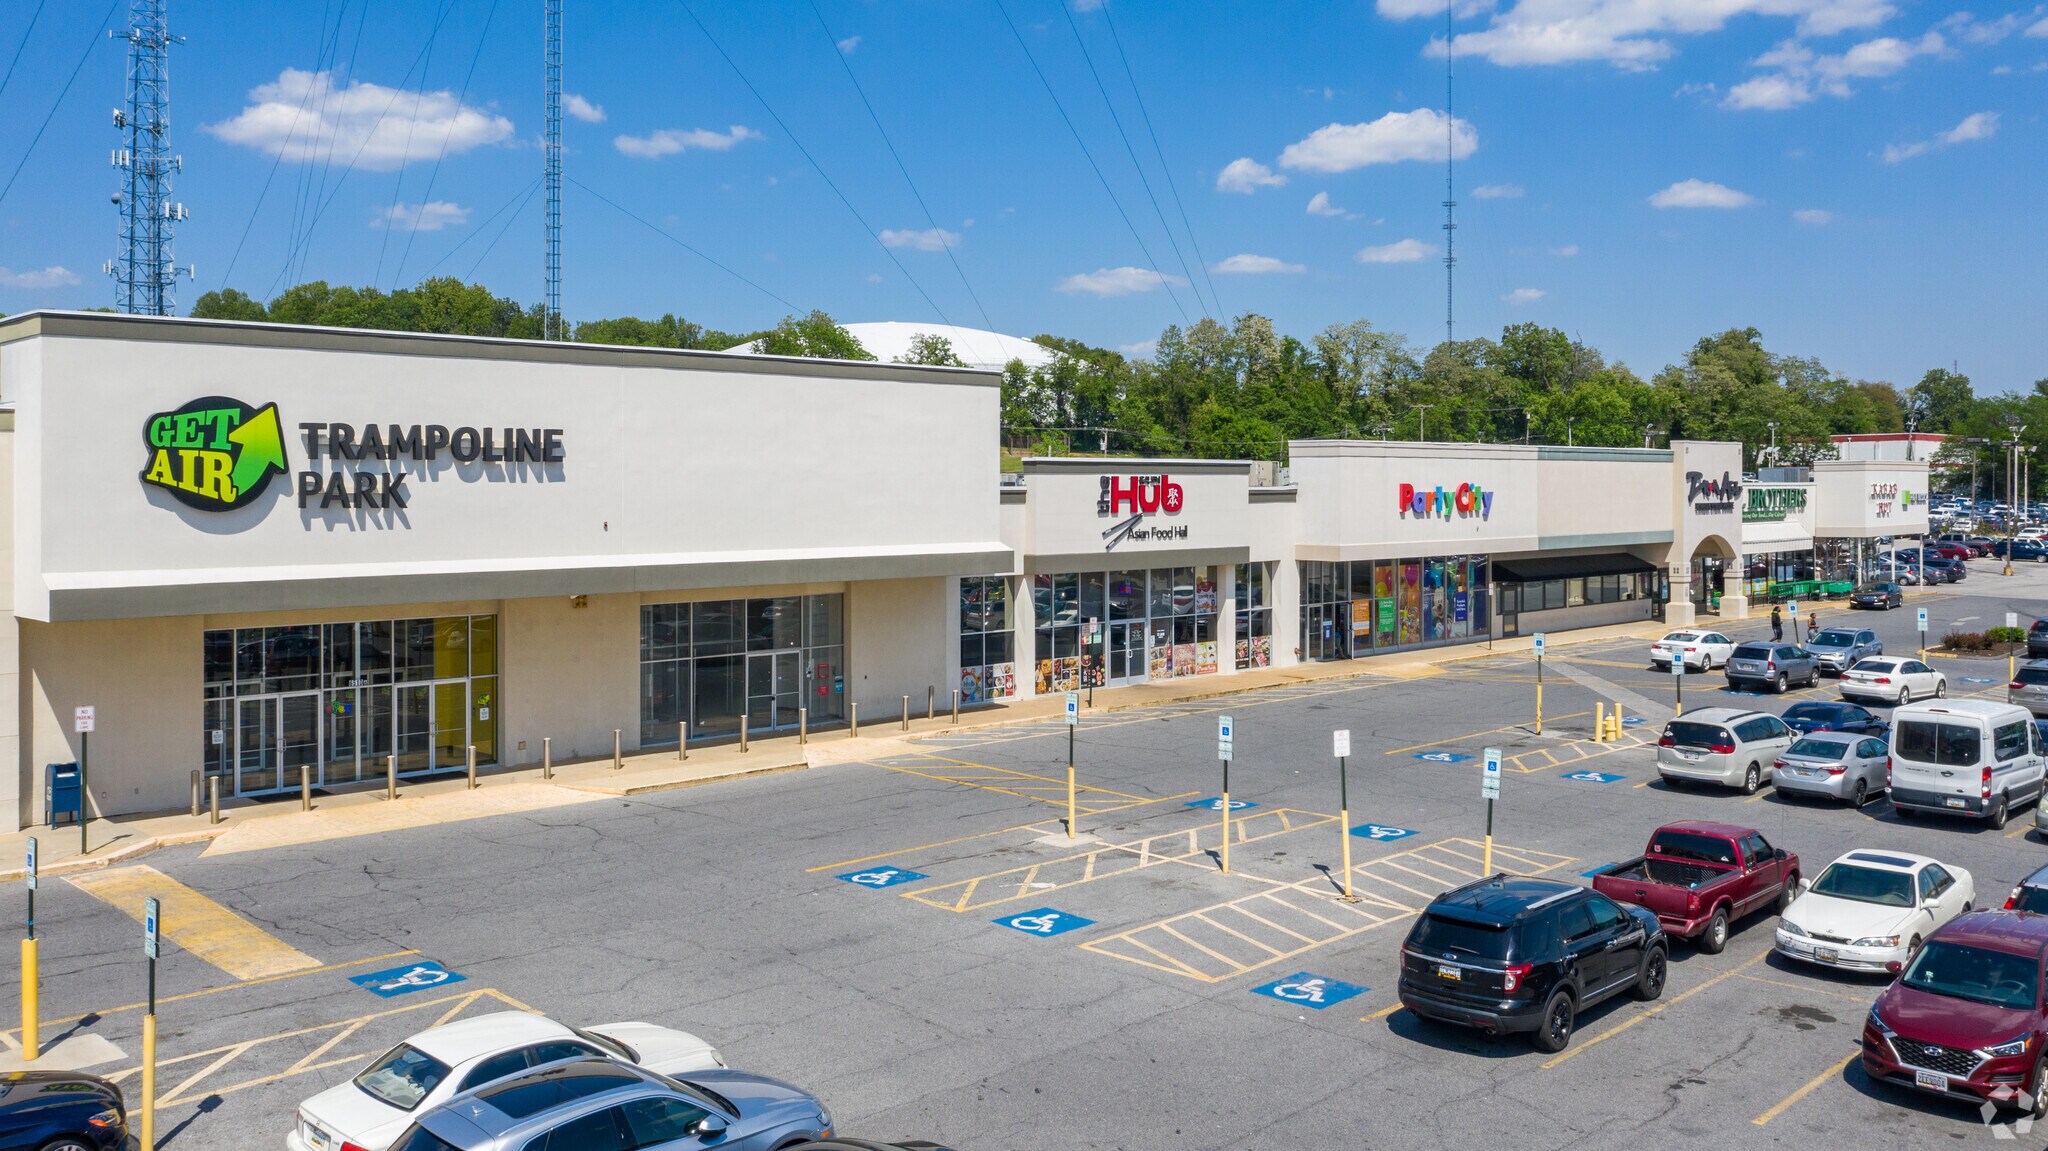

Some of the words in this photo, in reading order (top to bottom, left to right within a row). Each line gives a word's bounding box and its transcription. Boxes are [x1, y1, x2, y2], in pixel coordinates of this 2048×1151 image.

[150, 408, 240, 451] GET
[298, 422, 564, 463] TRAMPOLINE
[146, 449, 237, 503] AIR
[298, 471, 408, 509] PARK
[1097, 475, 1110, 514] the
[1110, 474, 1184, 514] Hub
[1399, 483, 1456, 517] Party
[1455, 482, 1494, 516] City
[1747, 488, 1807, 509] BROTHERS
[1127, 527, 1150, 539] Asian
[1151, 526, 1174, 539] Food
[1174, 525, 1188, 538] Hall
